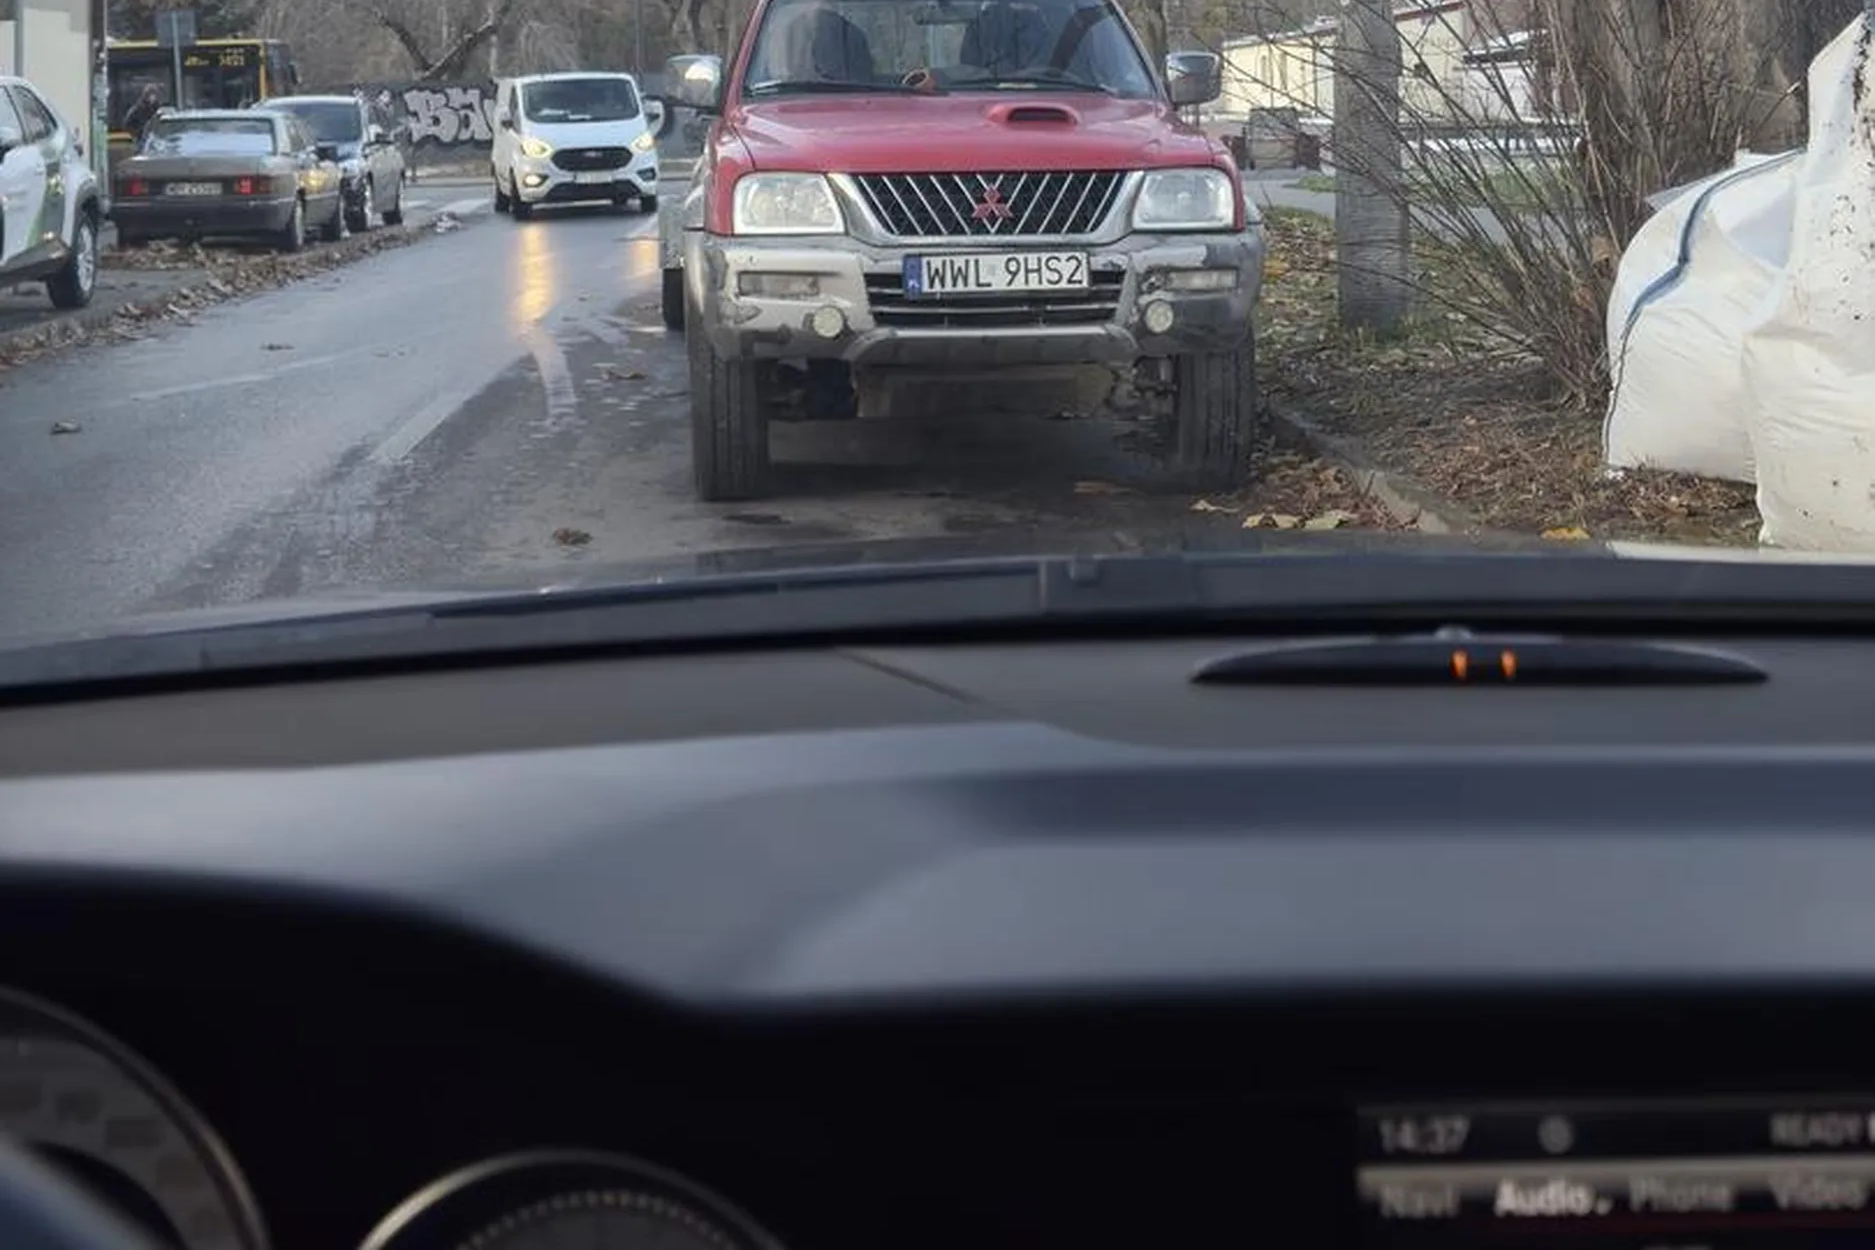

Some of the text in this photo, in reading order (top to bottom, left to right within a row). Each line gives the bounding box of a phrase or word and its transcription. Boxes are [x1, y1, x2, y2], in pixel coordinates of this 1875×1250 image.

[926, 255, 1083, 290] WWL 9HS2
[1380, 1175, 1868, 1219] Navi Audio Phone Video
